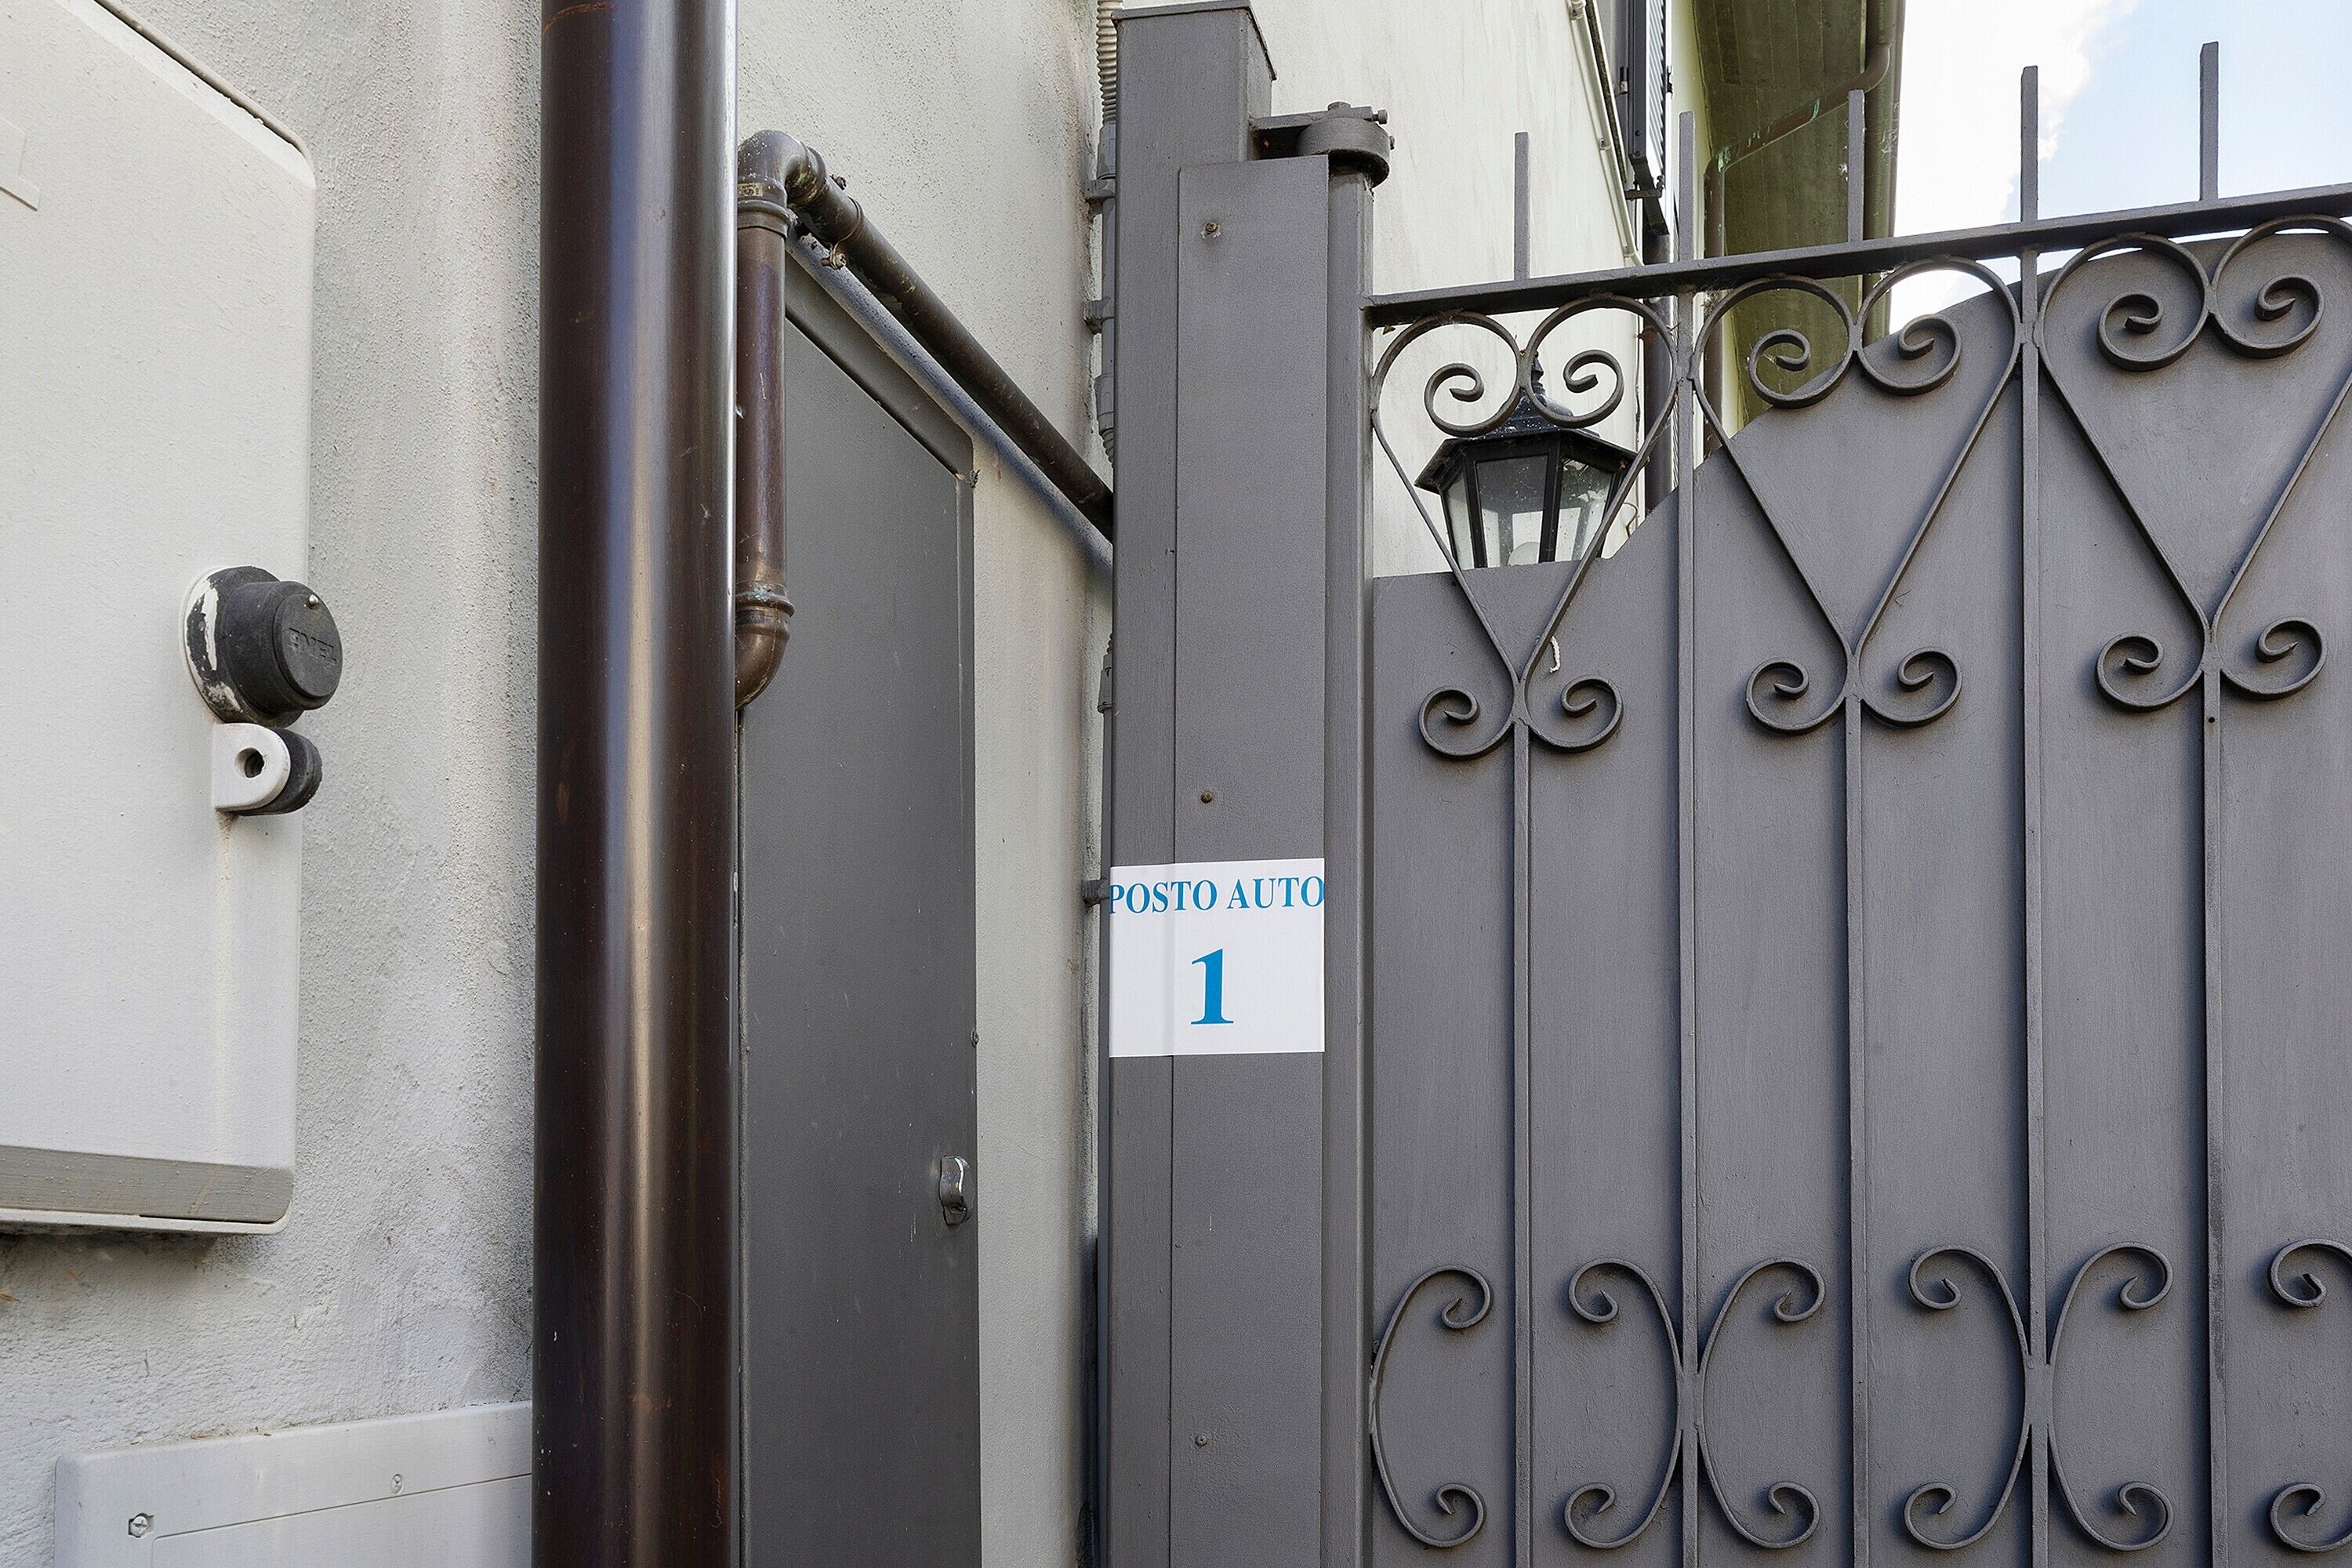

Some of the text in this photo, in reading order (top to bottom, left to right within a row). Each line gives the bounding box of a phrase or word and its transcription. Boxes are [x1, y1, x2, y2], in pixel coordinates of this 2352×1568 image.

[288, 626, 337, 666] ENEL
[1110, 876, 1325, 913] POSTO AUTO
[1190, 948, 1234, 1025] 1
